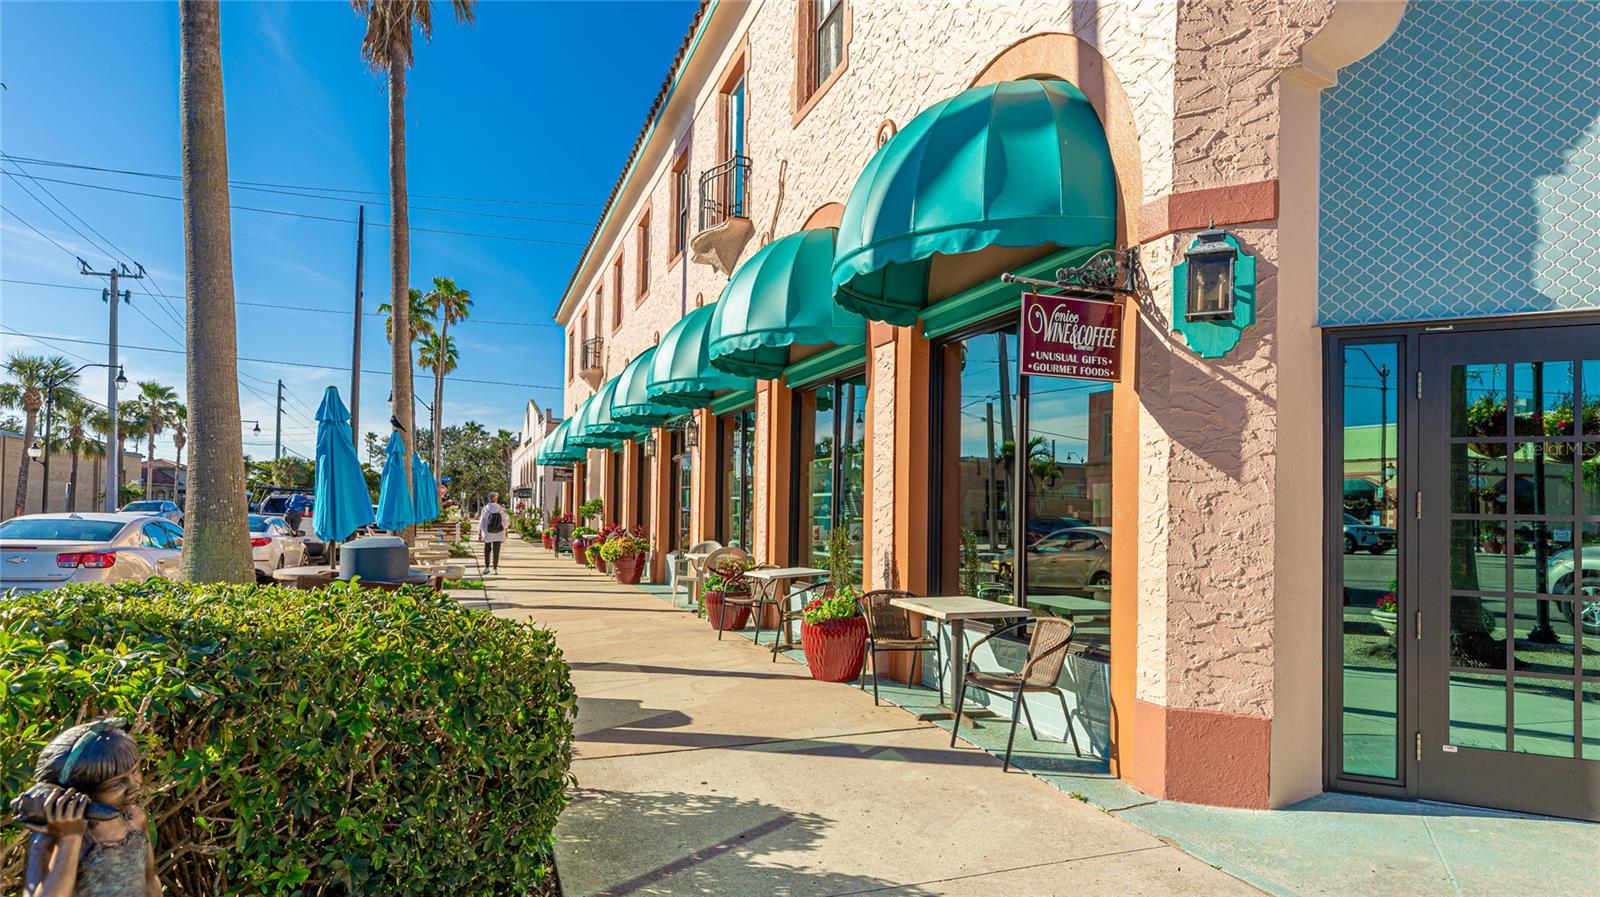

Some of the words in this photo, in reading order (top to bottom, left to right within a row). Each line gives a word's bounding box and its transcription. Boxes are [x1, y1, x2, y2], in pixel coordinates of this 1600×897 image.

[1028, 303, 1079, 334] Venice
[1036, 351, 1078, 363] UNUSUAL
[1082, 355, 1108, 365] GIFTS
[1033, 362, 1077, 374] GOURMET
[1080, 367, 1110, 377] FOODS
